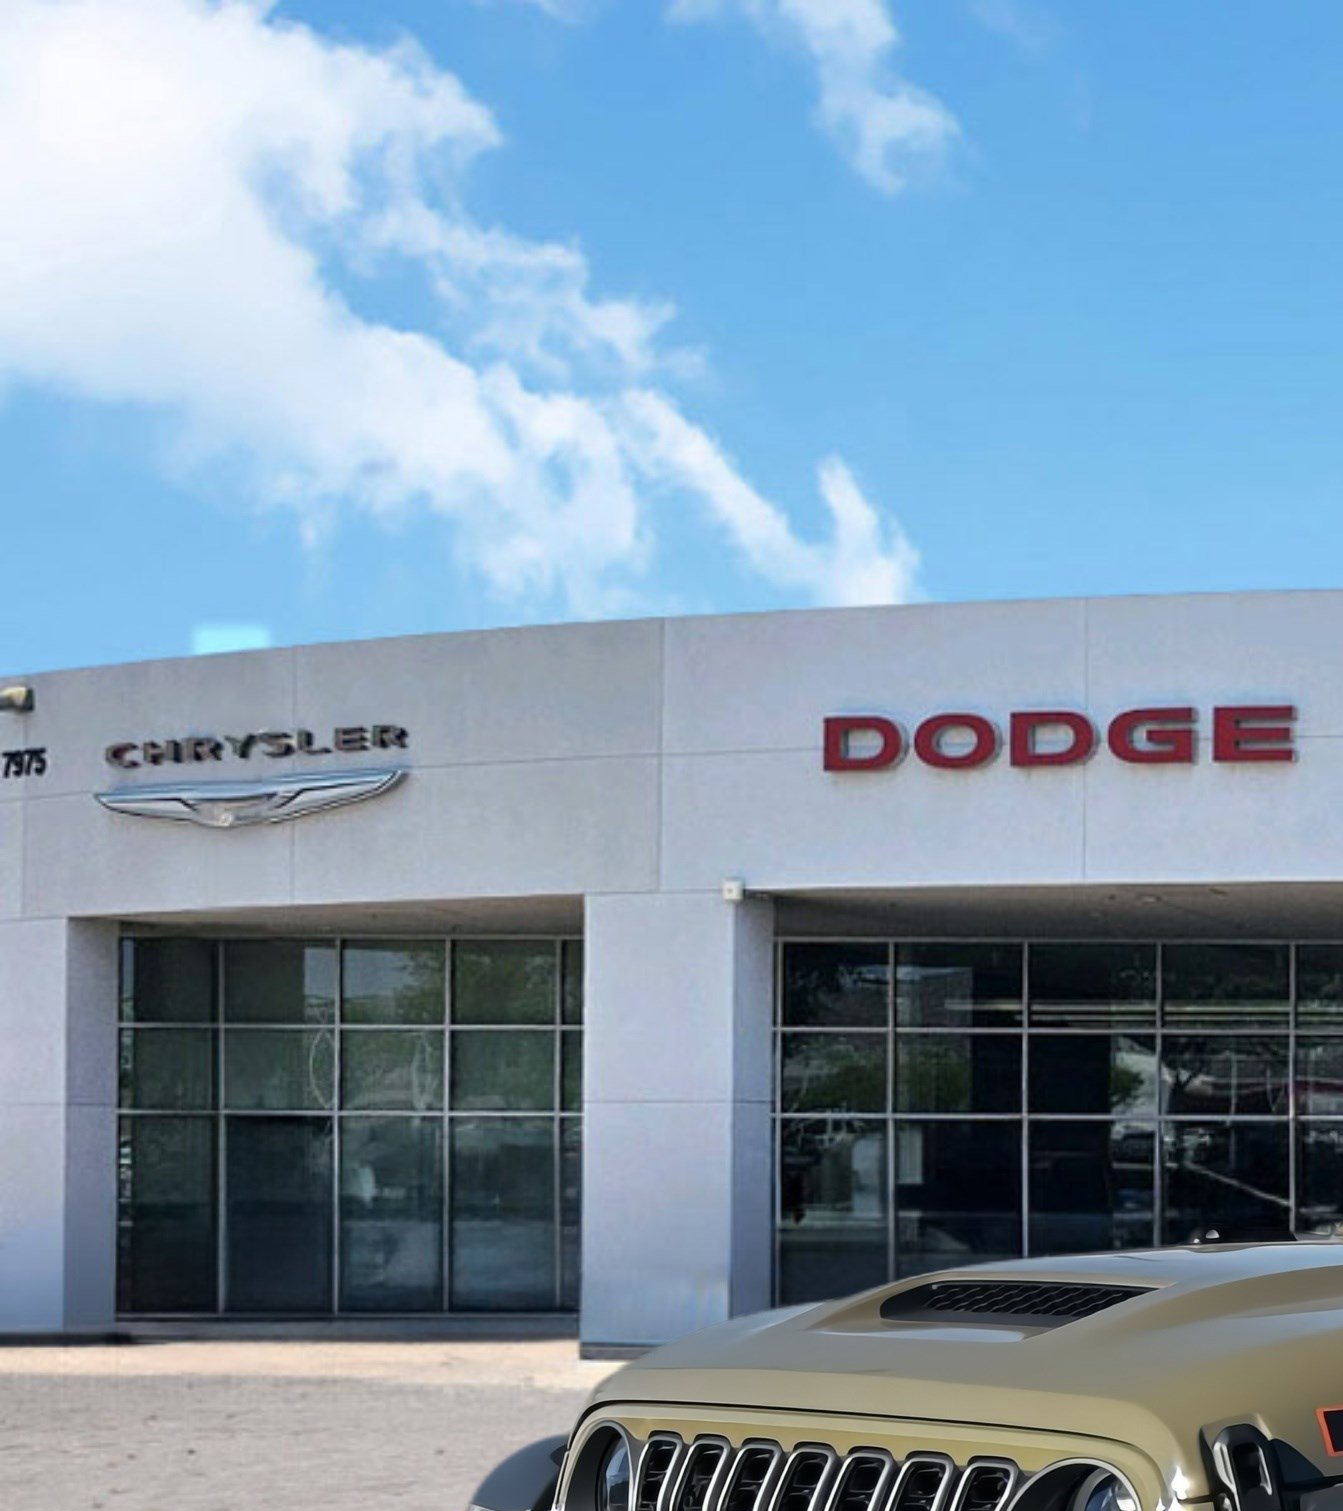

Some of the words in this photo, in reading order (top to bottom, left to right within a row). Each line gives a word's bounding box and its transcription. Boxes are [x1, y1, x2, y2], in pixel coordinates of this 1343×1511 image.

[105, 724, 410, 769] CHRYSLER
[823, 705, 1297, 771] DODGE
[2, 747, 47, 779] 7975
